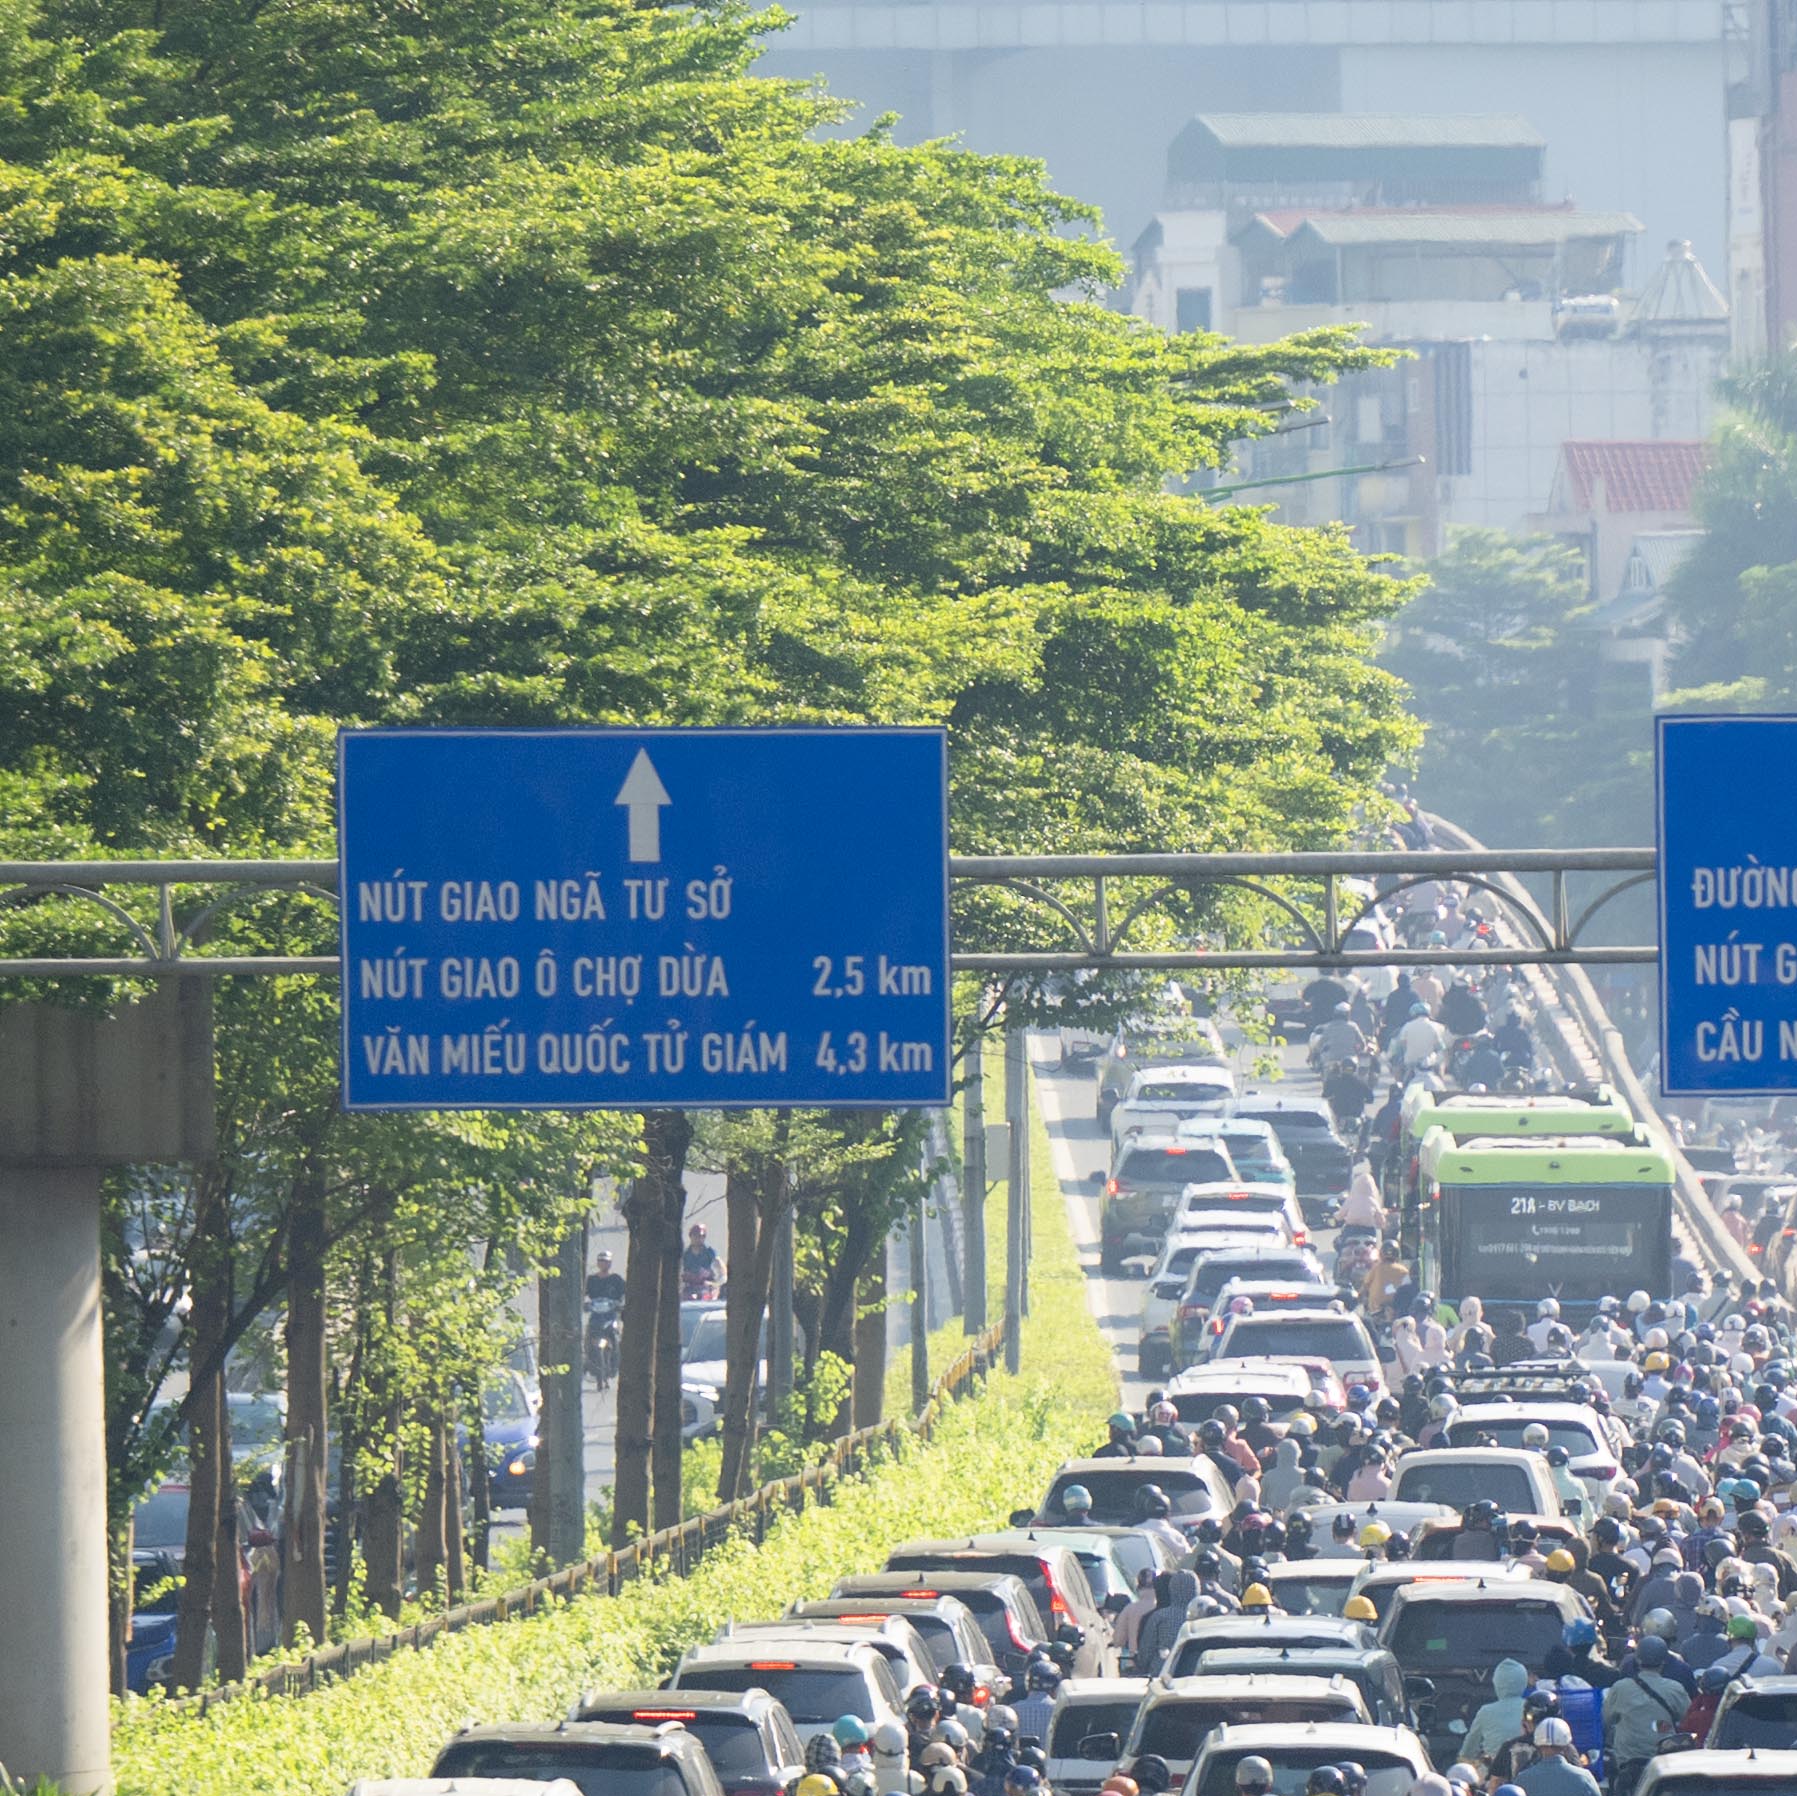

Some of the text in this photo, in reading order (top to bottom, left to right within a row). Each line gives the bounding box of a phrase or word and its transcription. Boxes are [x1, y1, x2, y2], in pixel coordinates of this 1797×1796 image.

[359, 865, 733, 922] NÚT GIAO NGÃ TƯ SỞ
[361, 943, 728, 1005] NÚT GIAO Ô CHỢ DỪA
[813, 955, 931, 998] 2,5 km
[1696, 930, 1763, 985] NÚT
[364, 1018, 787, 1075] VĂN MIẾU QUỐC TỬ GIÁM
[816, 1032, 932, 1075] 4,3 km
[1697, 1008, 1763, 1062] CẦU
[1511, 1197, 1536, 1214] 21A
